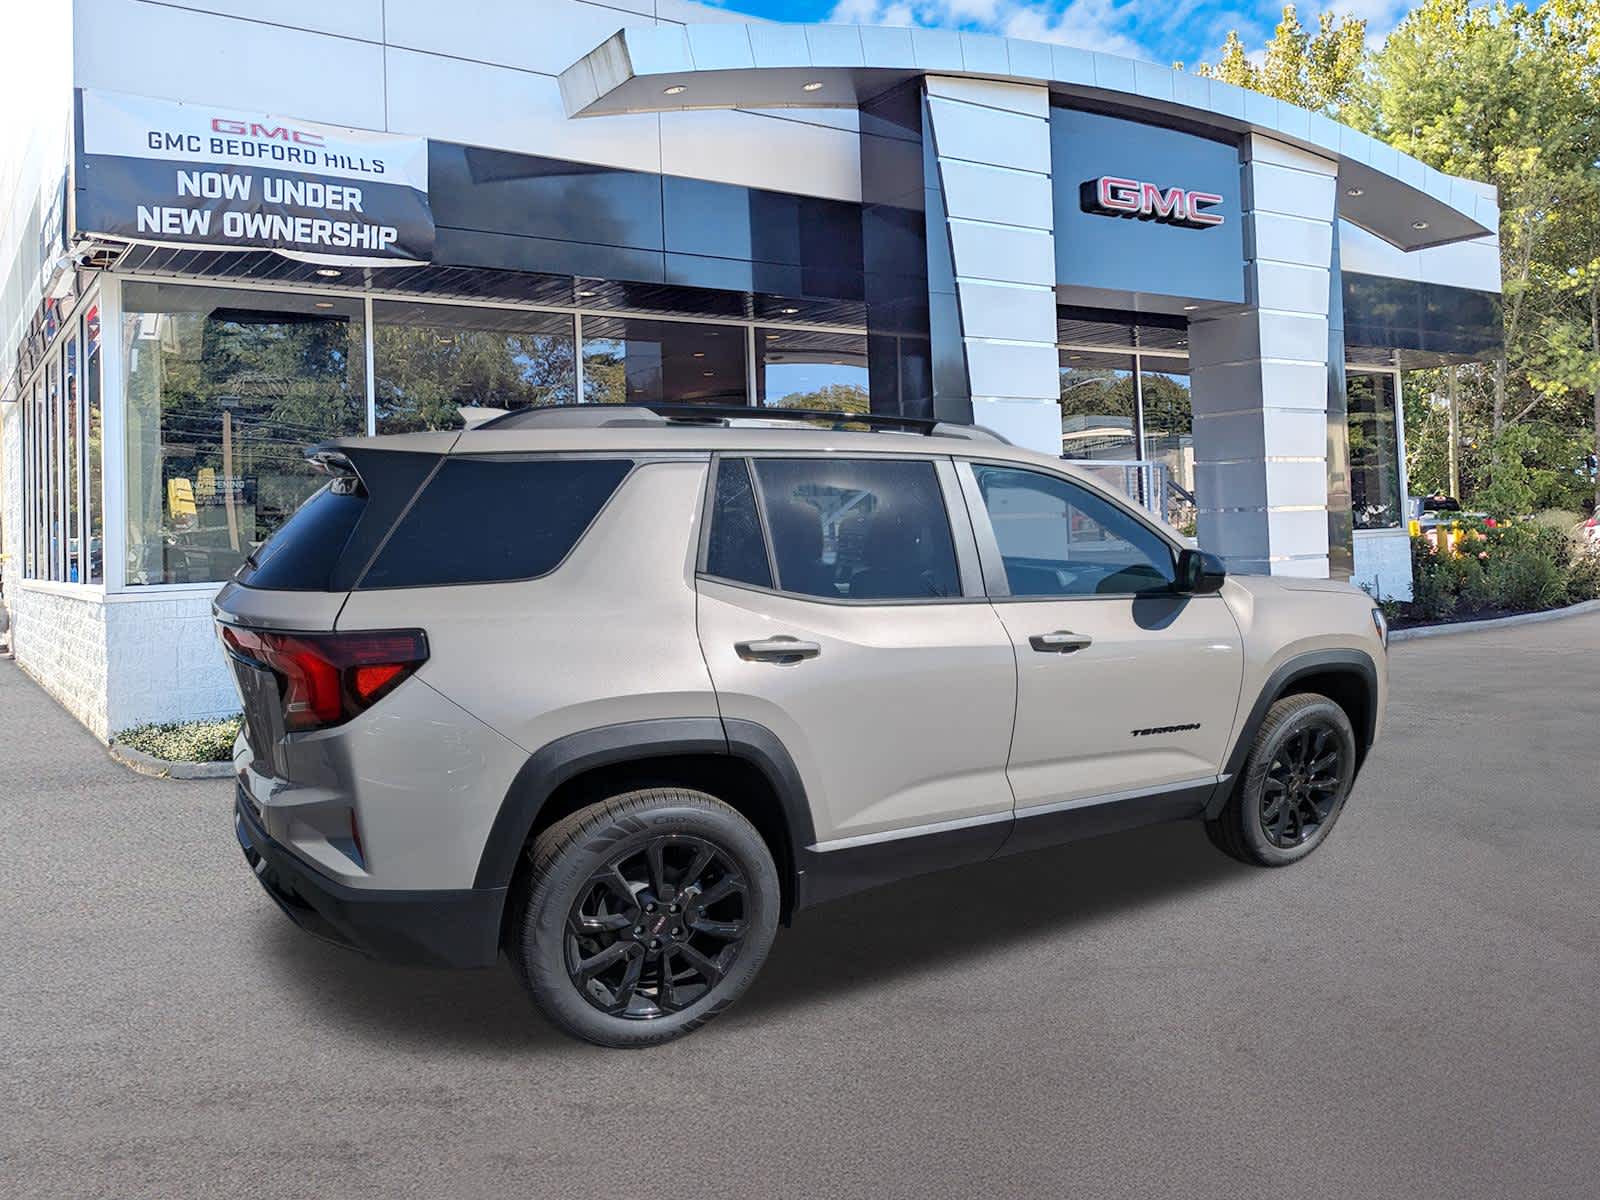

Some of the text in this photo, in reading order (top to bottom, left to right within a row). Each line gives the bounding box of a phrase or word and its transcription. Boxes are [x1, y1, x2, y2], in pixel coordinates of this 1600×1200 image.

[148, 131, 385, 174] GMC BEDFORD HILLS
[211, 118, 325, 148] GMC
[177, 170, 363, 213] NOW UNDER
[1097, 175, 1225, 225] GMC
[137, 205, 398, 250] NEW OWNERSHIP
[1130, 722, 1201, 737] TERRAIN
